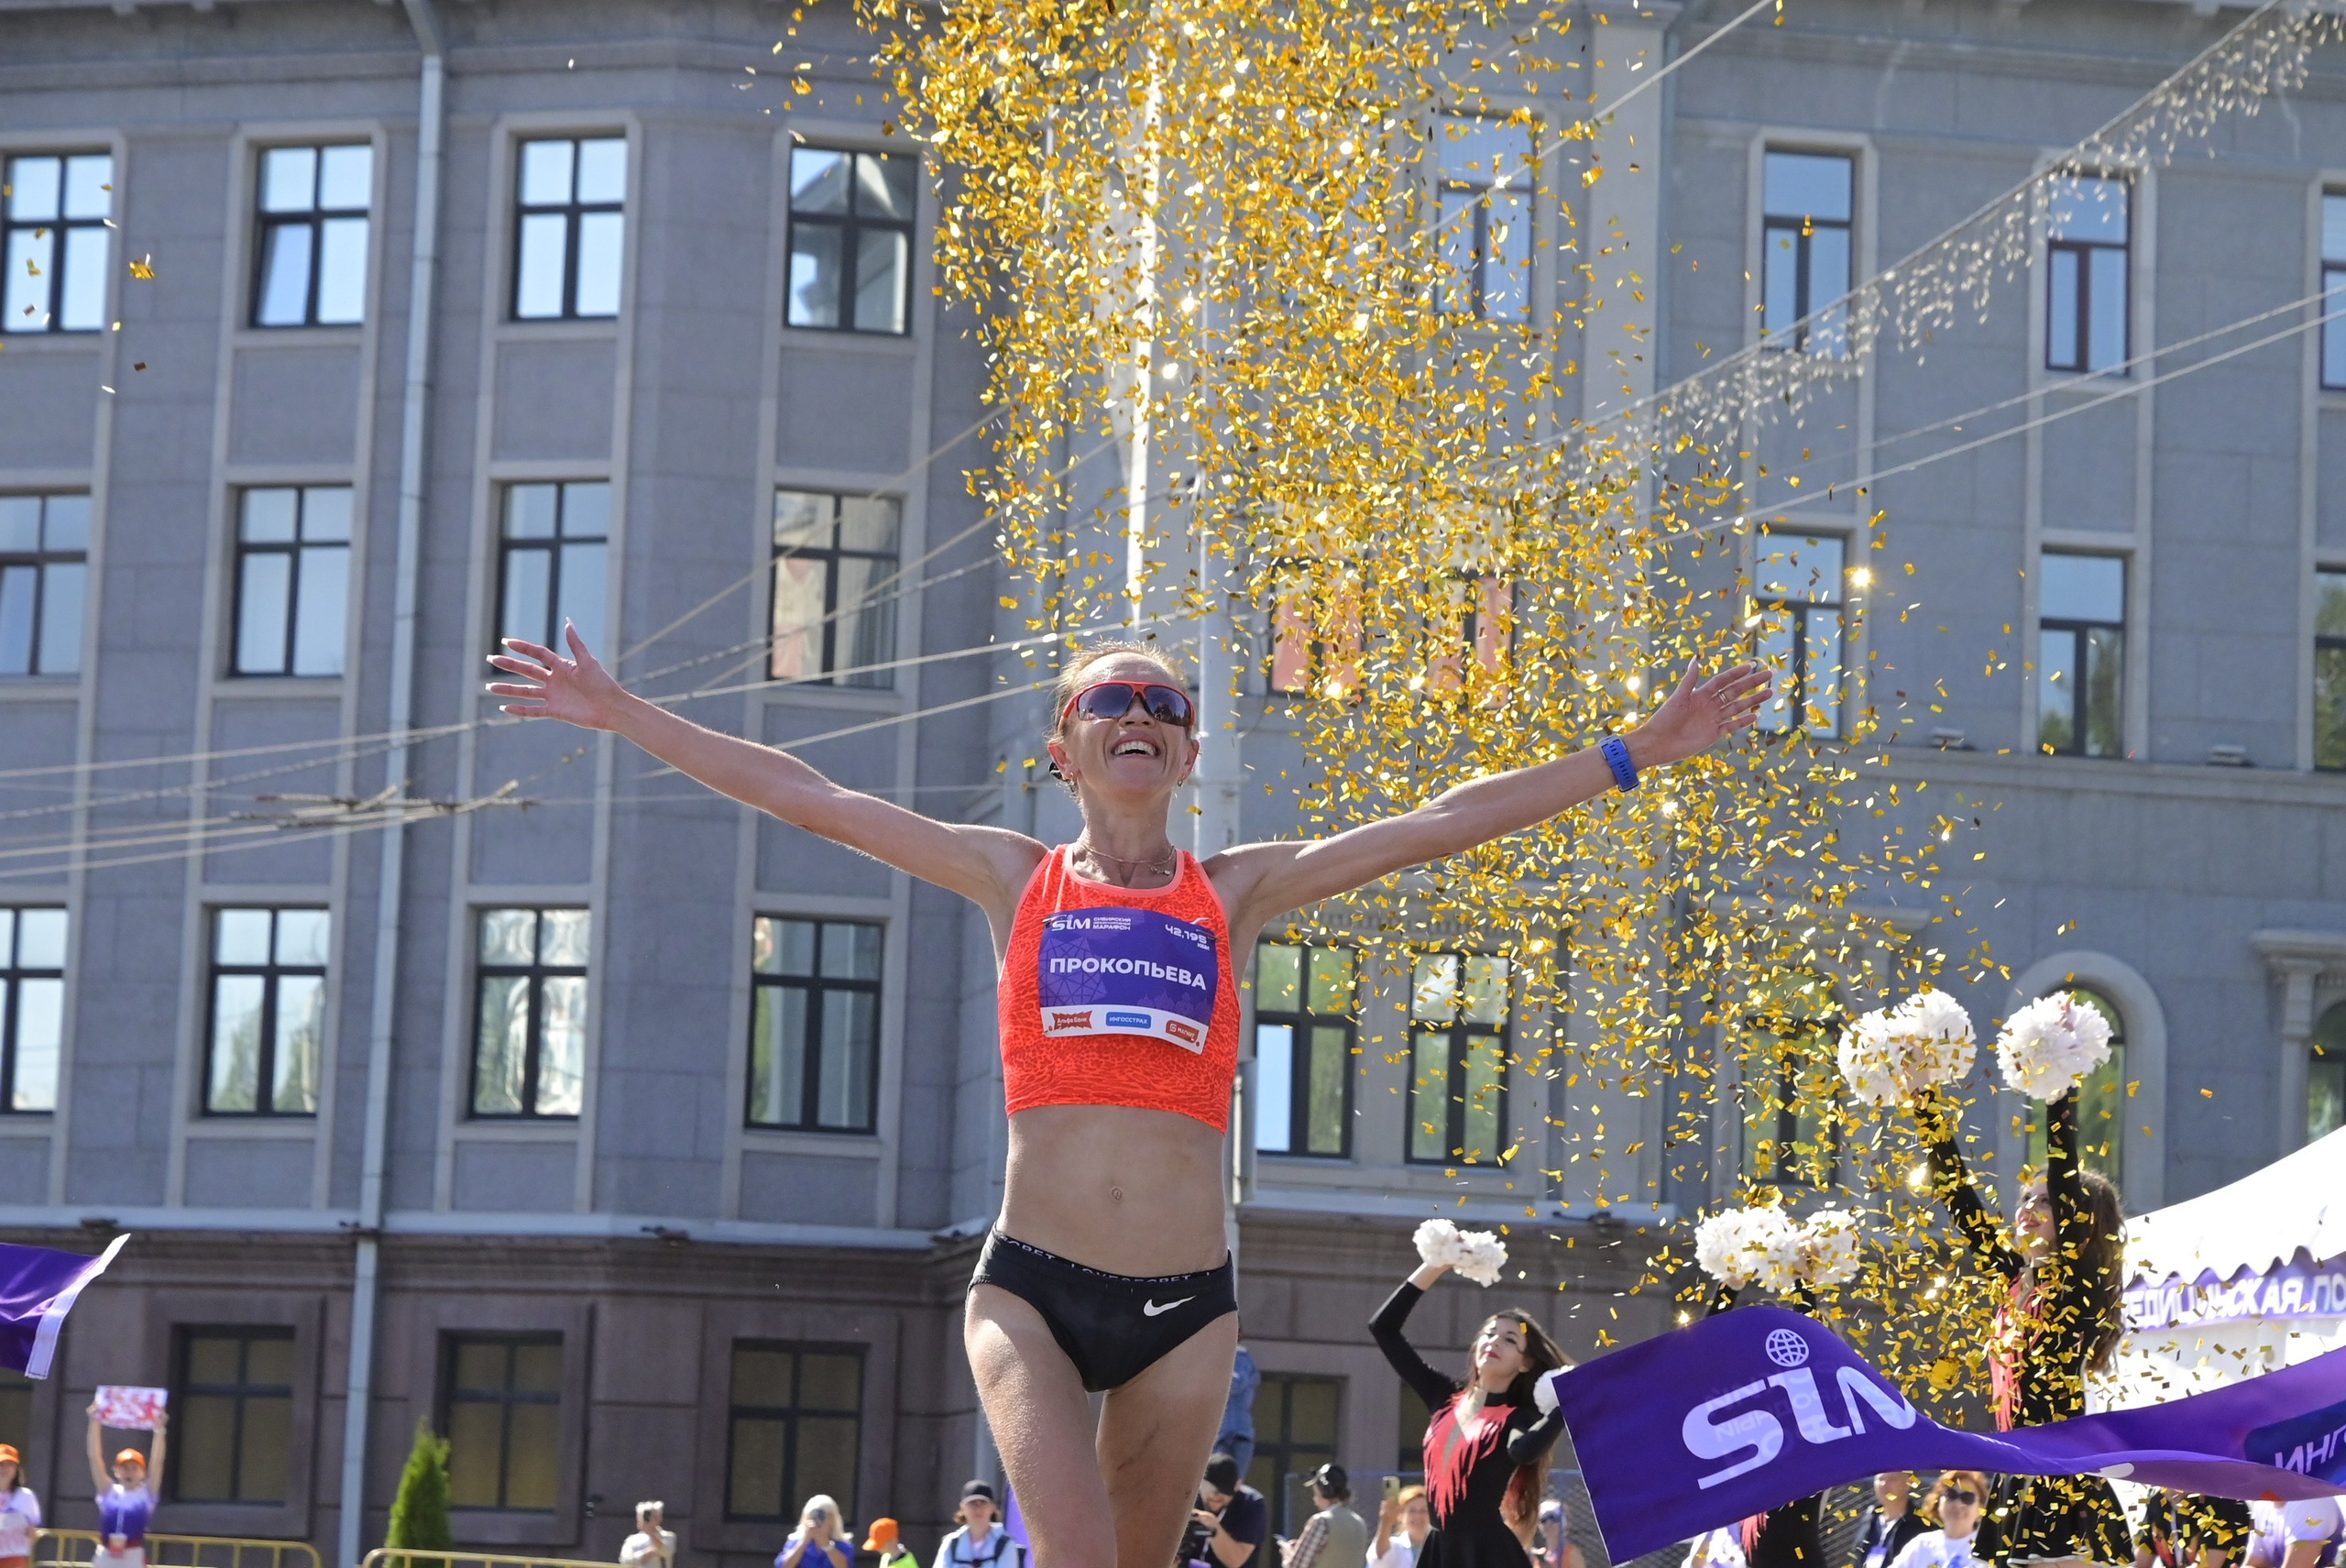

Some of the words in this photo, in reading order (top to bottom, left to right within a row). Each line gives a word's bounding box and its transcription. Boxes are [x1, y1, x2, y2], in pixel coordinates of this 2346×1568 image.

[1165, 924, 1207, 944] 42,195
[1049, 958, 1206, 991] ПРОКОПЬЕВА
[1109, 1016, 1147, 1025] ИНГОССТРАХ
[2275, 1423, 2346, 1475] ИНГ
